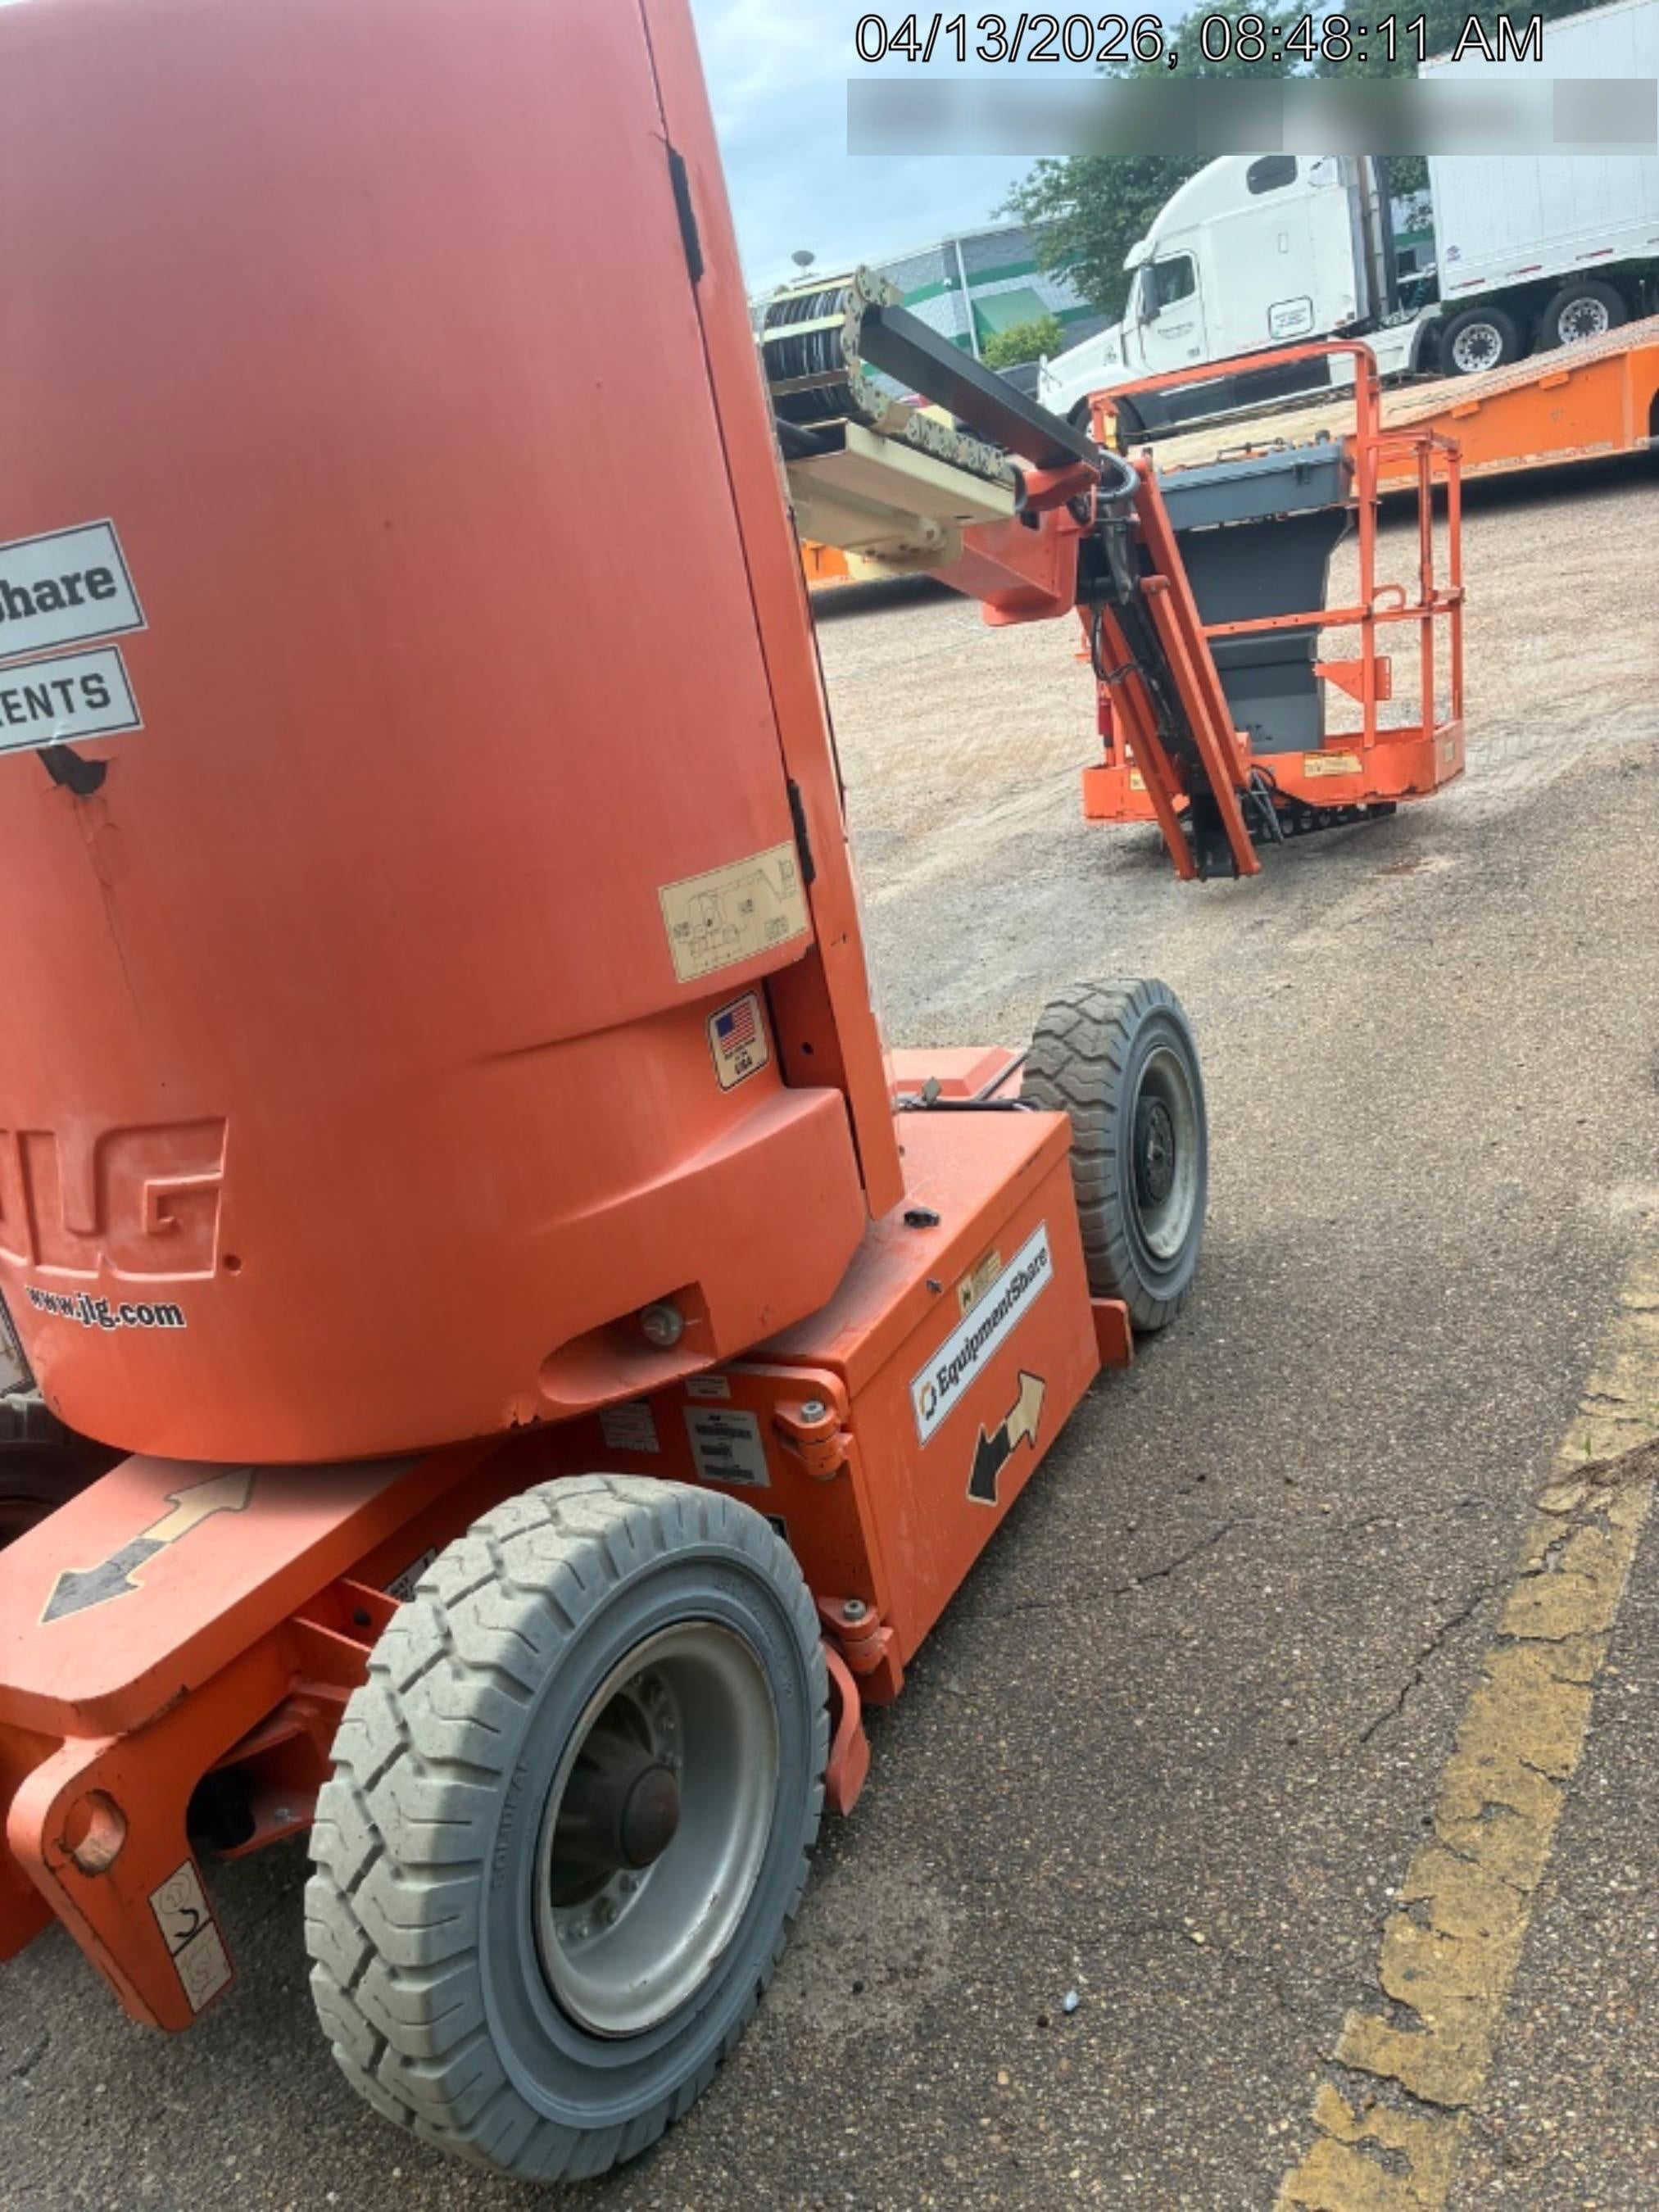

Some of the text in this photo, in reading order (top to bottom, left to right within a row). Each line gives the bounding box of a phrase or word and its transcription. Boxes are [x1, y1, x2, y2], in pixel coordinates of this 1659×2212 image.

[0, 567, 116, 623] hare
[0, 673, 111, 727] ENTS
[25, 1285, 186, 1329] www.jlg.com
[936, 1247, 1048, 1396] EquipmentShare
